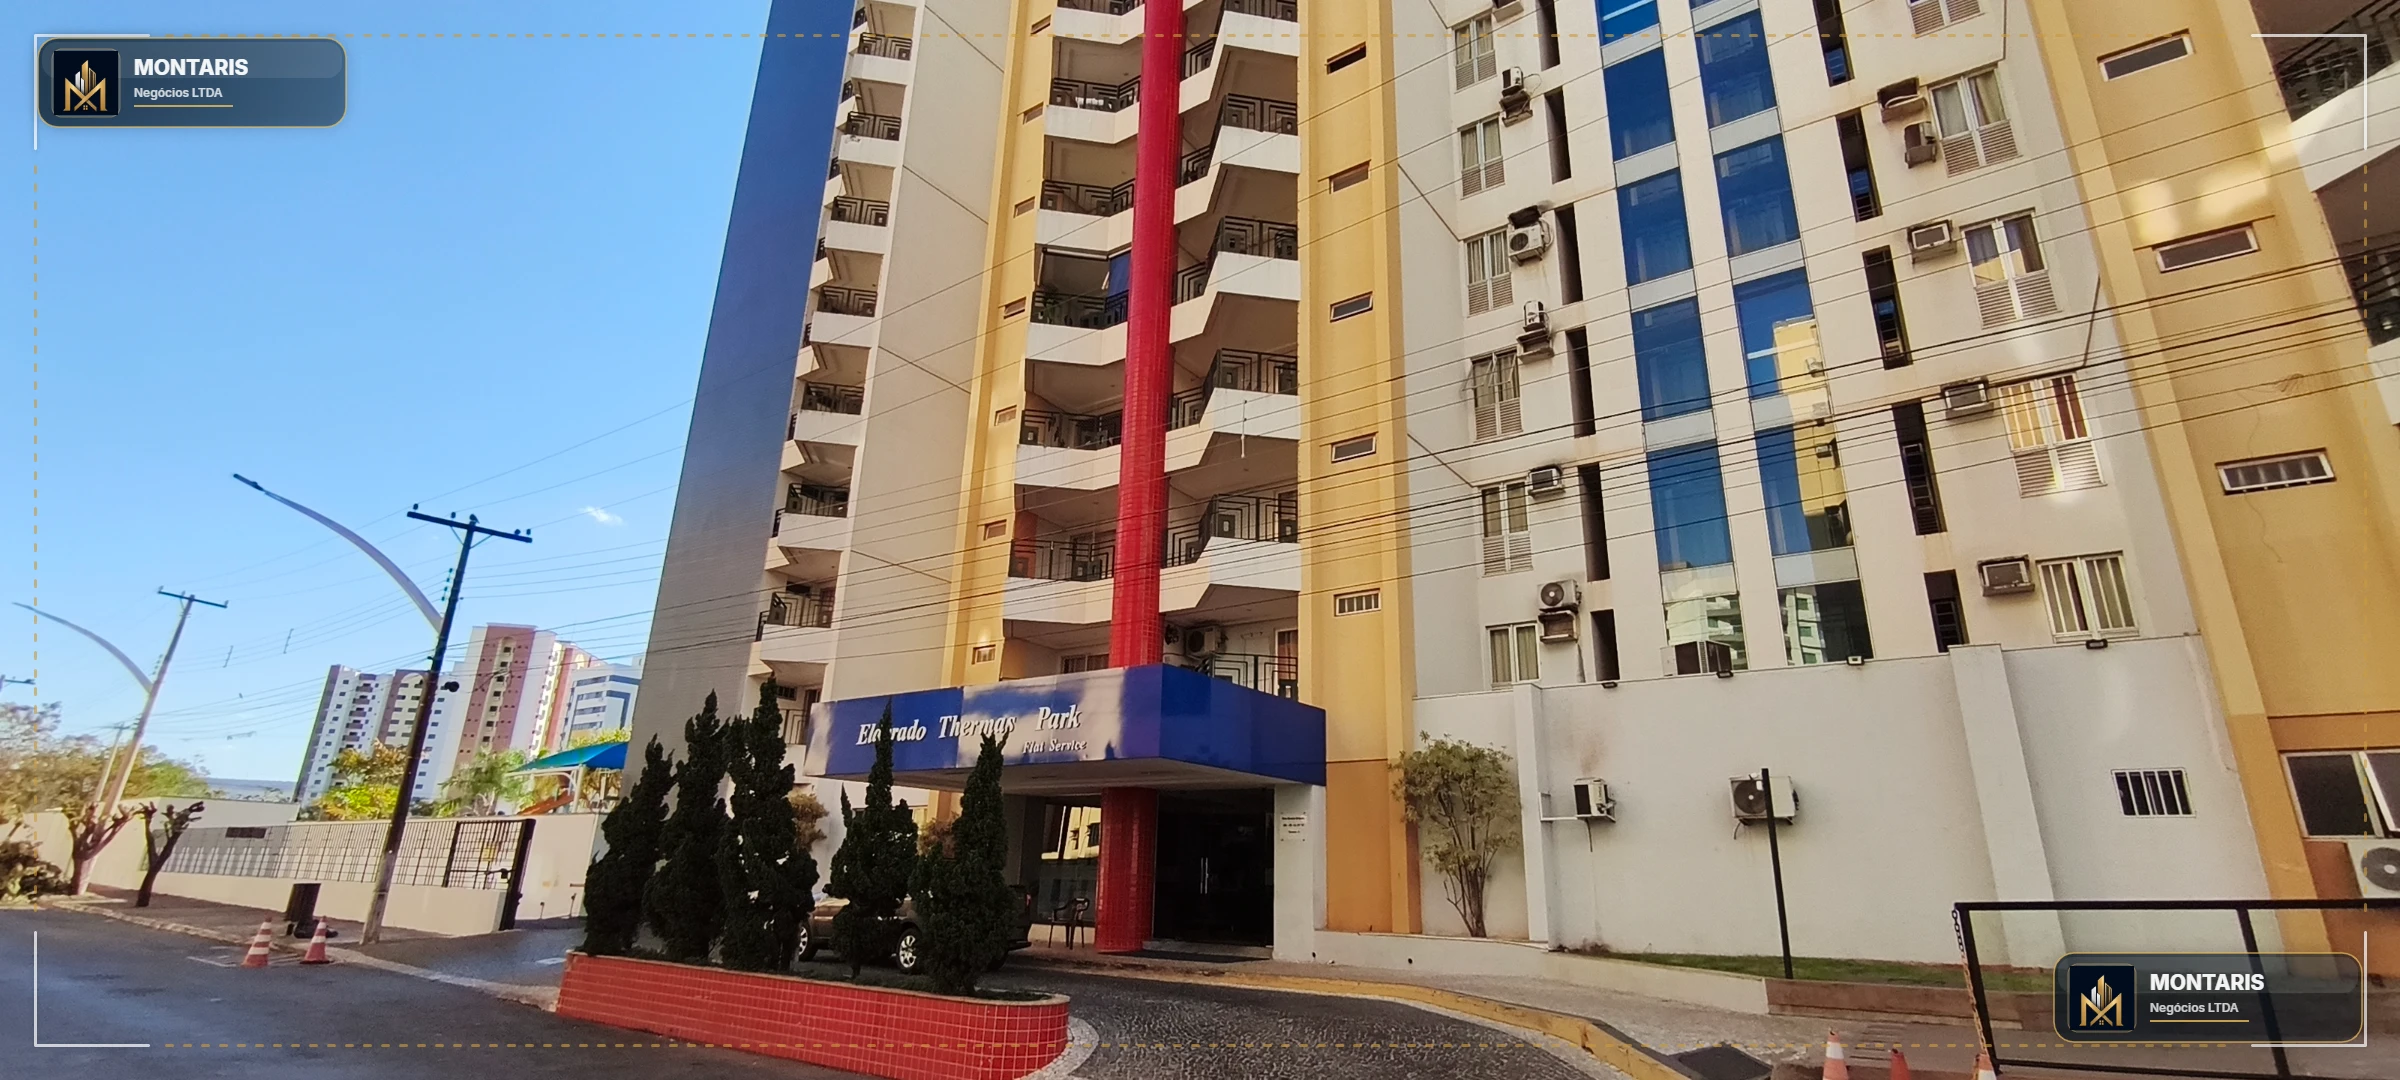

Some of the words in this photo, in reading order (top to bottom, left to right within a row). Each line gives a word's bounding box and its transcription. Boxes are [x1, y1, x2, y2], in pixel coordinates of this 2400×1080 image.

[855, 718, 927, 745] Eldrado
[938, 714, 1018, 739] Thermas
[1034, 704, 1082, 731] Park
[1023, 740, 1045, 753] Flat
[1049, 738, 1087, 752] Service
